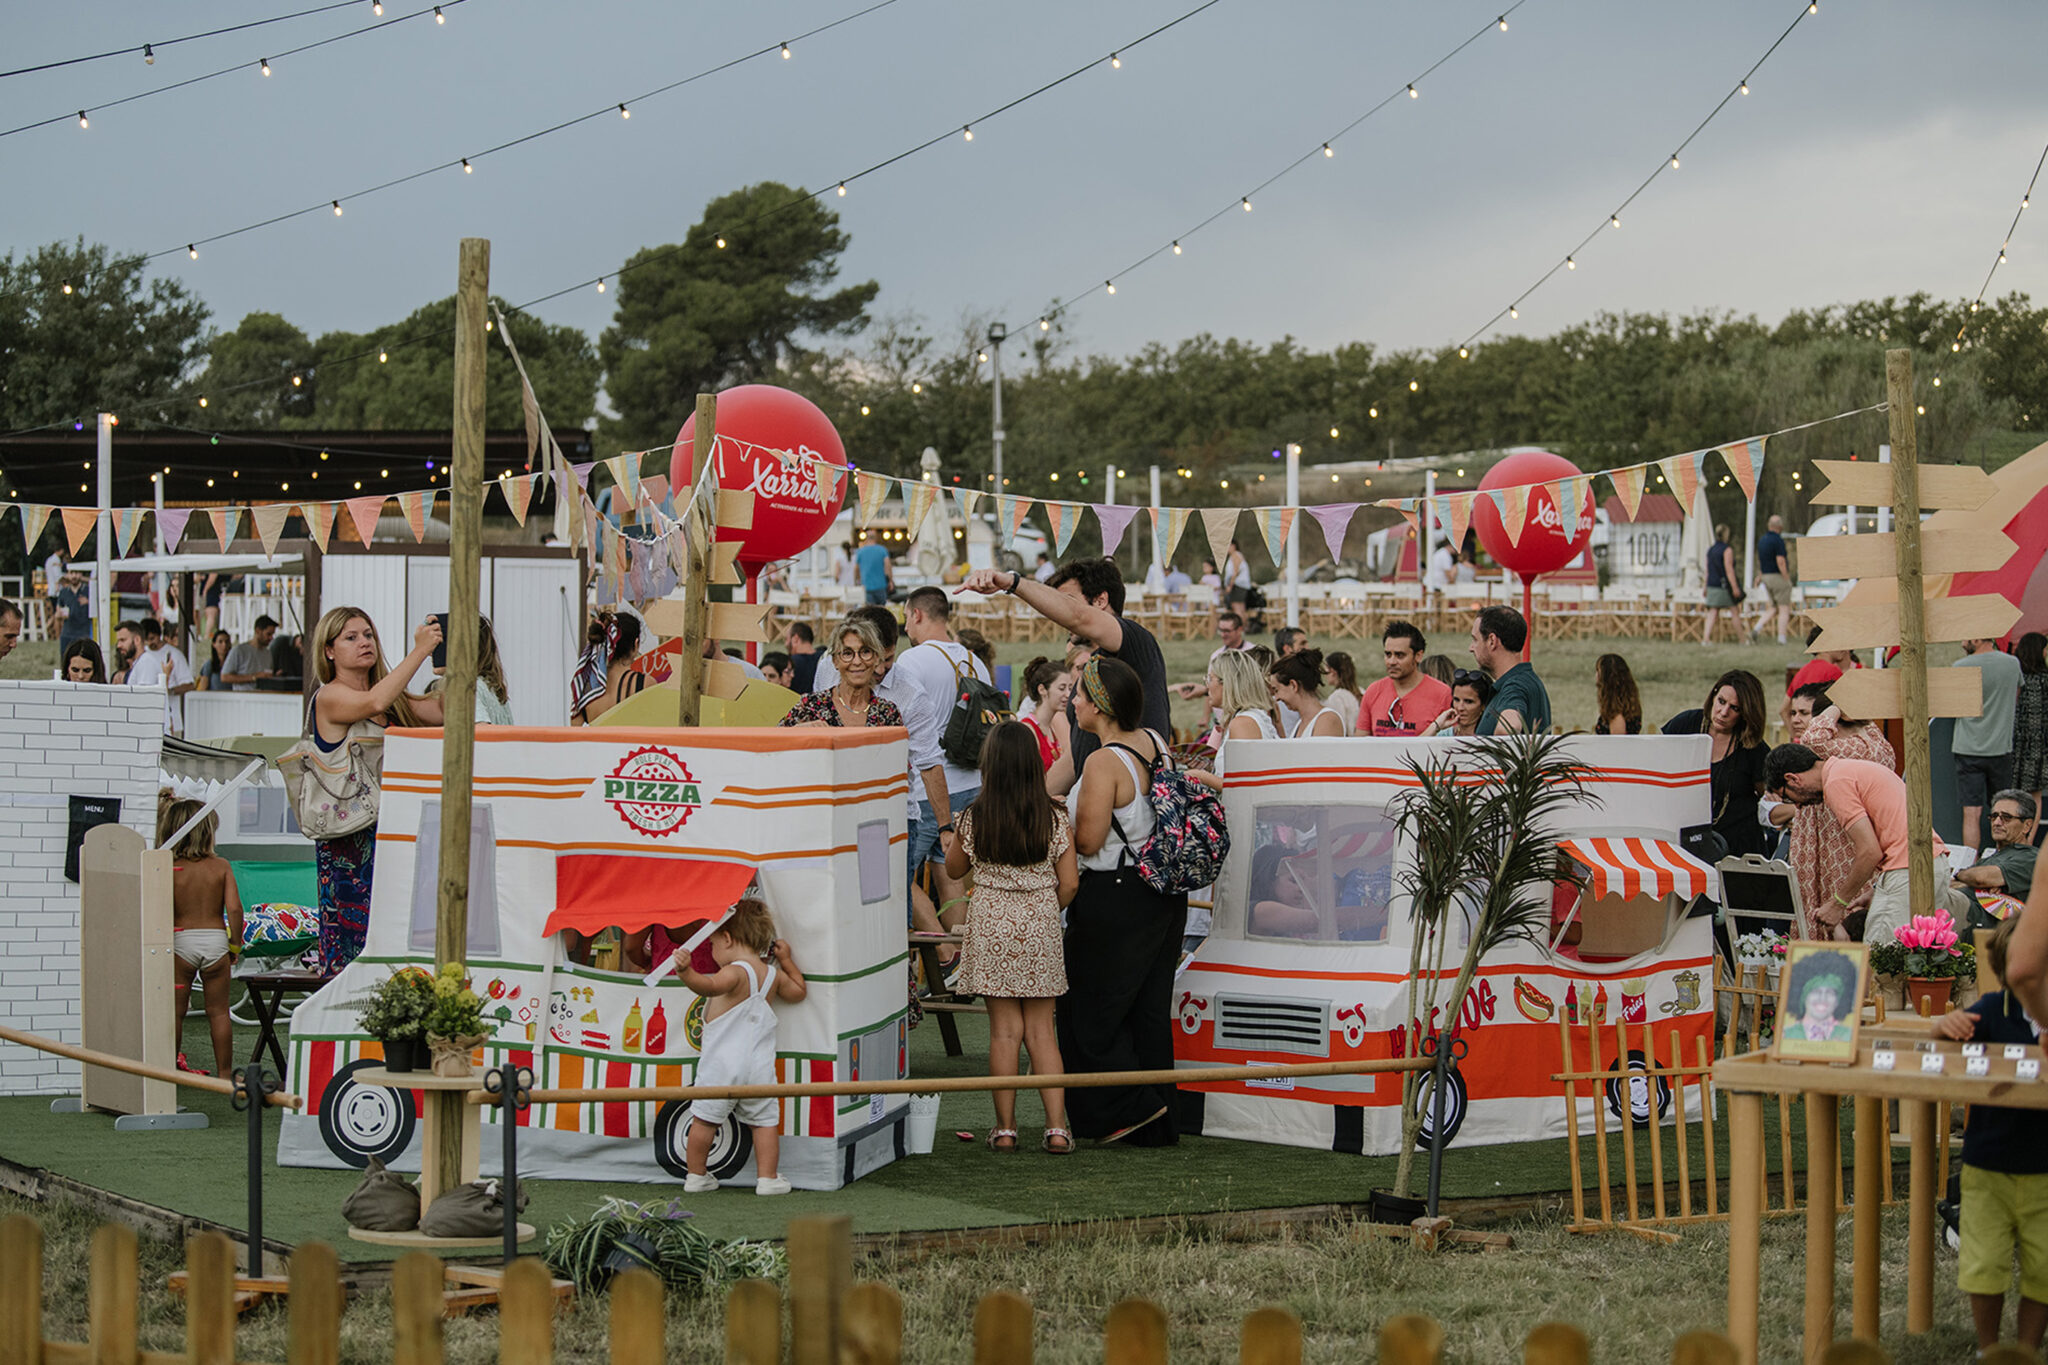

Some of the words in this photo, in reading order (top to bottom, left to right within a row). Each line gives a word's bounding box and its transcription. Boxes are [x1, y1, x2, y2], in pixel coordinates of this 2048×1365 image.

[1626, 532, 1671, 567] 100%
[633, 753, 652, 767] ROLE
[654, 754, 673, 767] PLAY
[604, 779, 701, 804] PIZZA
[84, 805, 105, 813] MENU
[628, 810, 653, 829] FRESH
[664, 814, 678, 828] HOT
[1623, 996, 1644, 1021] Fries
